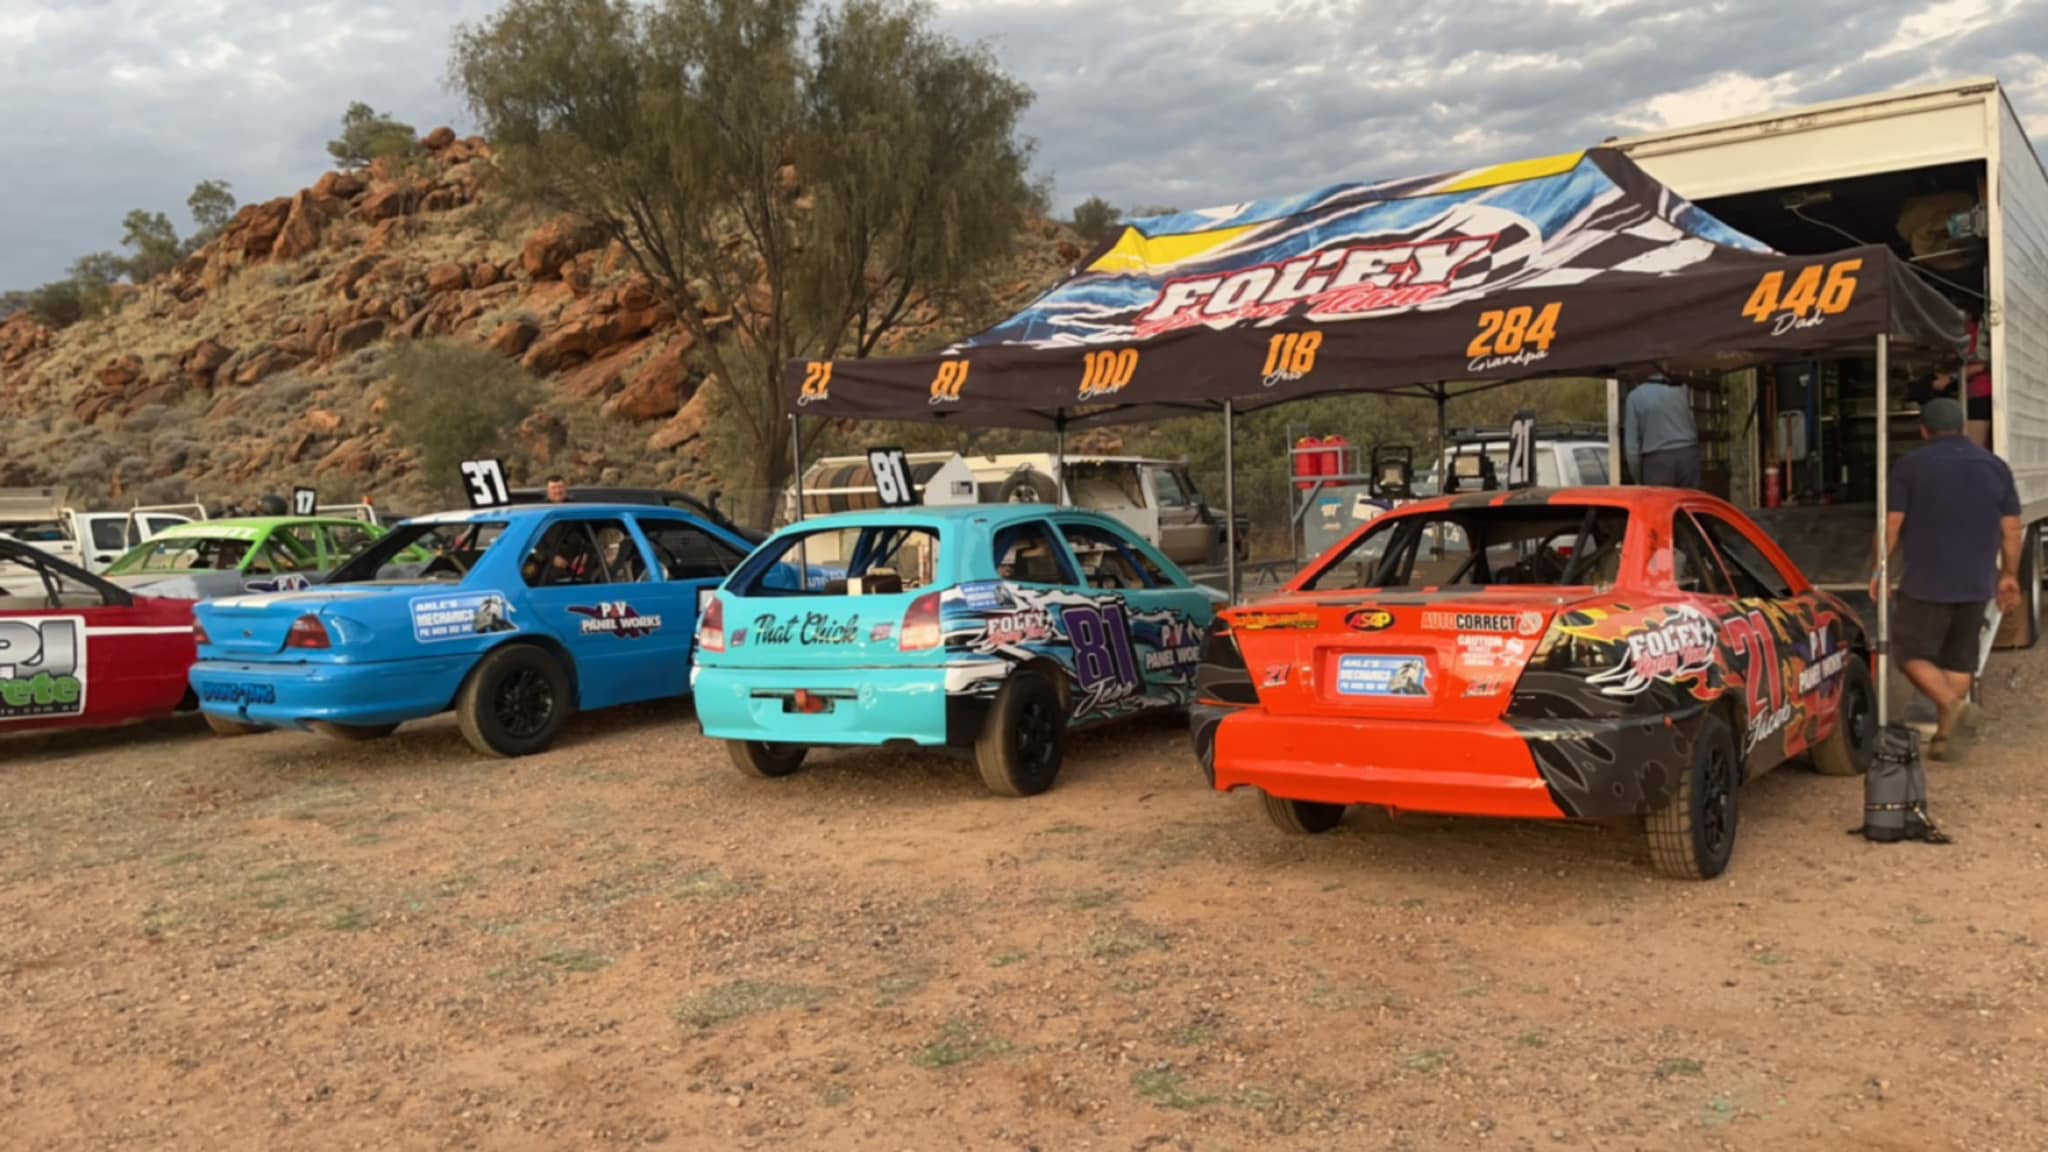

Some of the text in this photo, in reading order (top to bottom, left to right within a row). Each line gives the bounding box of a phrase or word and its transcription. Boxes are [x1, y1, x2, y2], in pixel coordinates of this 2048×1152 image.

[1138, 234, 1499, 323] FOLEY
[1742, 259, 1863, 322] 446
[1466, 302, 1562, 358] 284
[1770, 306, 1824, 336] Dad
[1079, 349, 1139, 392] 100
[1262, 331, 1322, 376] 118
[1467, 348, 1548, 372] Grandpa
[803, 362, 832, 396] 21
[931, 361, 969, 397] 81
[1510, 419, 1534, 484] 21
[461, 460, 508, 505] 37
[870, 451, 911, 503] 81
[296, 490, 315, 514] 17
[620, 615, 661, 629] WORKS
[754, 613, 799, 645] That
[800, 611, 859, 645] Chick
[1628, 621, 1704, 662] FOLEY
[1062, 604, 1138, 693] 81
[1723, 609, 1783, 732] 21
